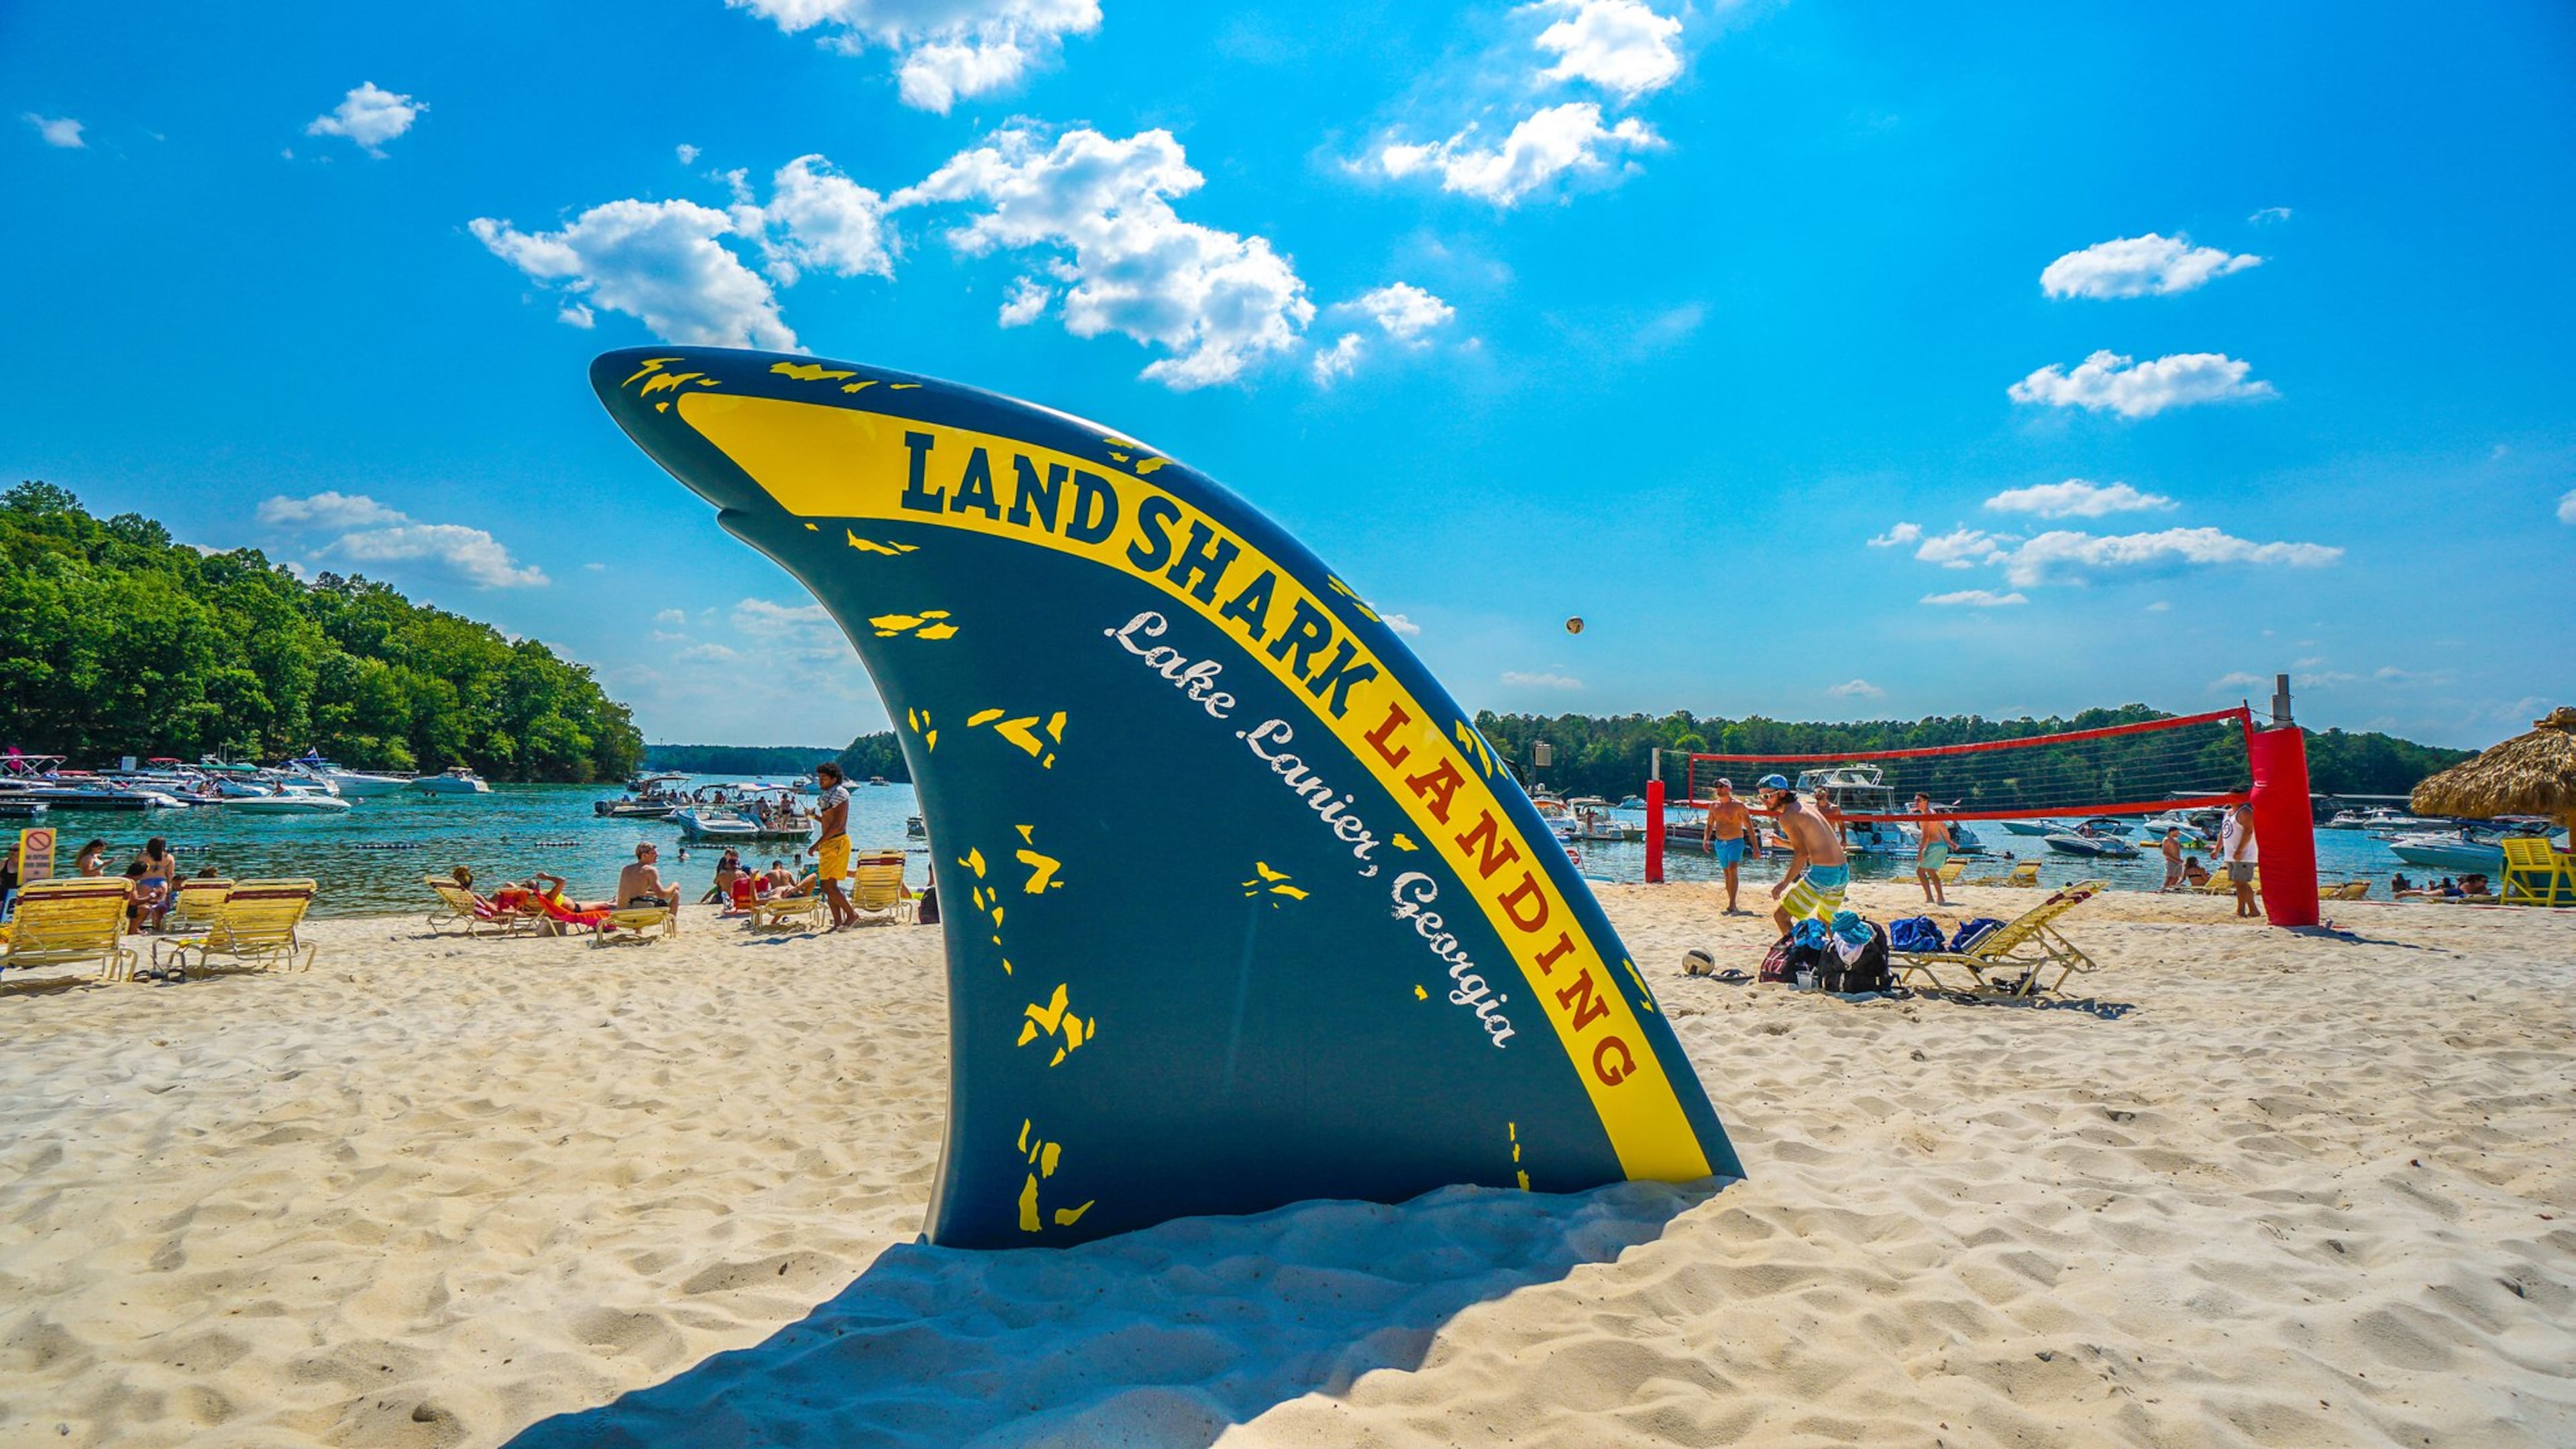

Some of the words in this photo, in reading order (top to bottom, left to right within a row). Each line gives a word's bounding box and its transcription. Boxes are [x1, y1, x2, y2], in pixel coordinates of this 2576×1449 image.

[900, 430, 1119, 545] LAND
[1126, 495, 1379, 720] SHARK
[1363, 701, 1638, 1087] LANDING
[1104, 610, 1236, 719] Lake
[1236, 718, 1380, 877] Lanier,
[1391, 871, 1515, 1049] Georgia
